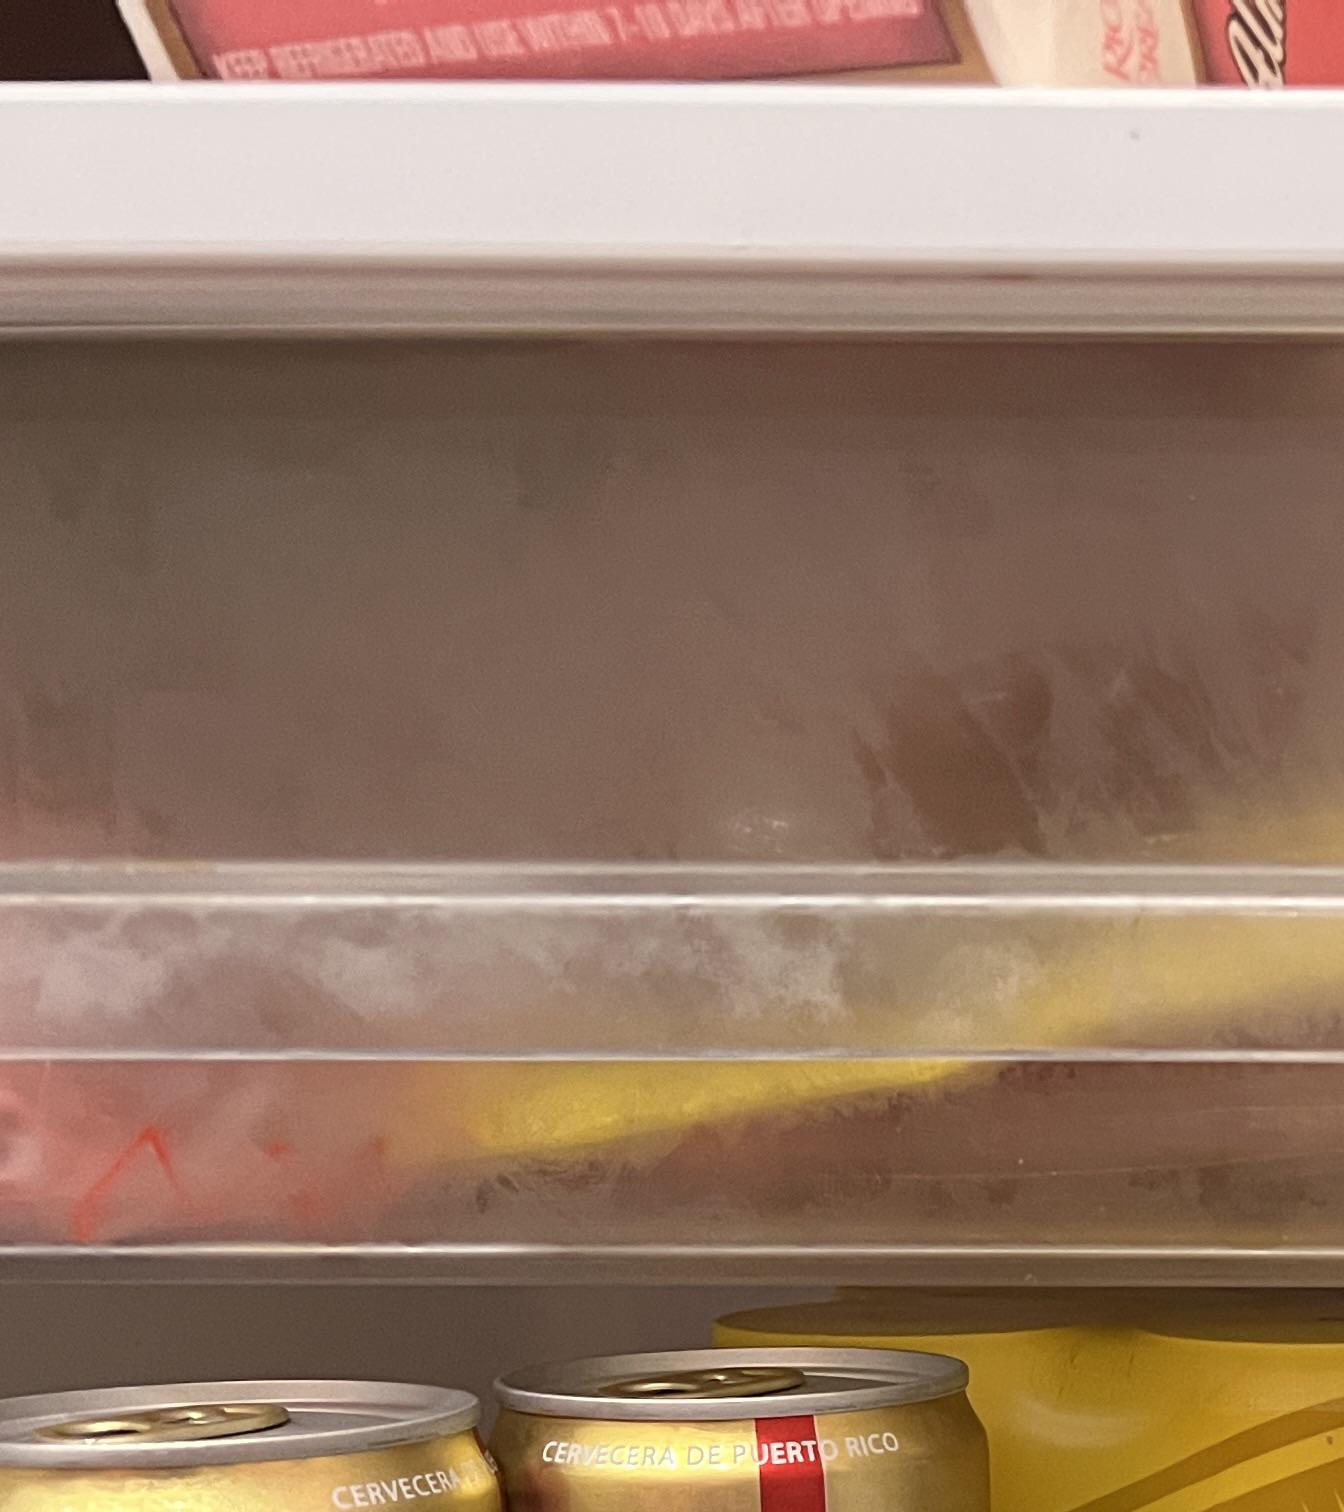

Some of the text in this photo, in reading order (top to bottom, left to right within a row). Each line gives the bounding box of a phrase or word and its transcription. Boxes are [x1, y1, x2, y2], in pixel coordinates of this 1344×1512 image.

[542, 1432, 900, 1467] CERVECERA DE PUERTO RICO
[332, 1465, 461, 1510] CERVECERA
